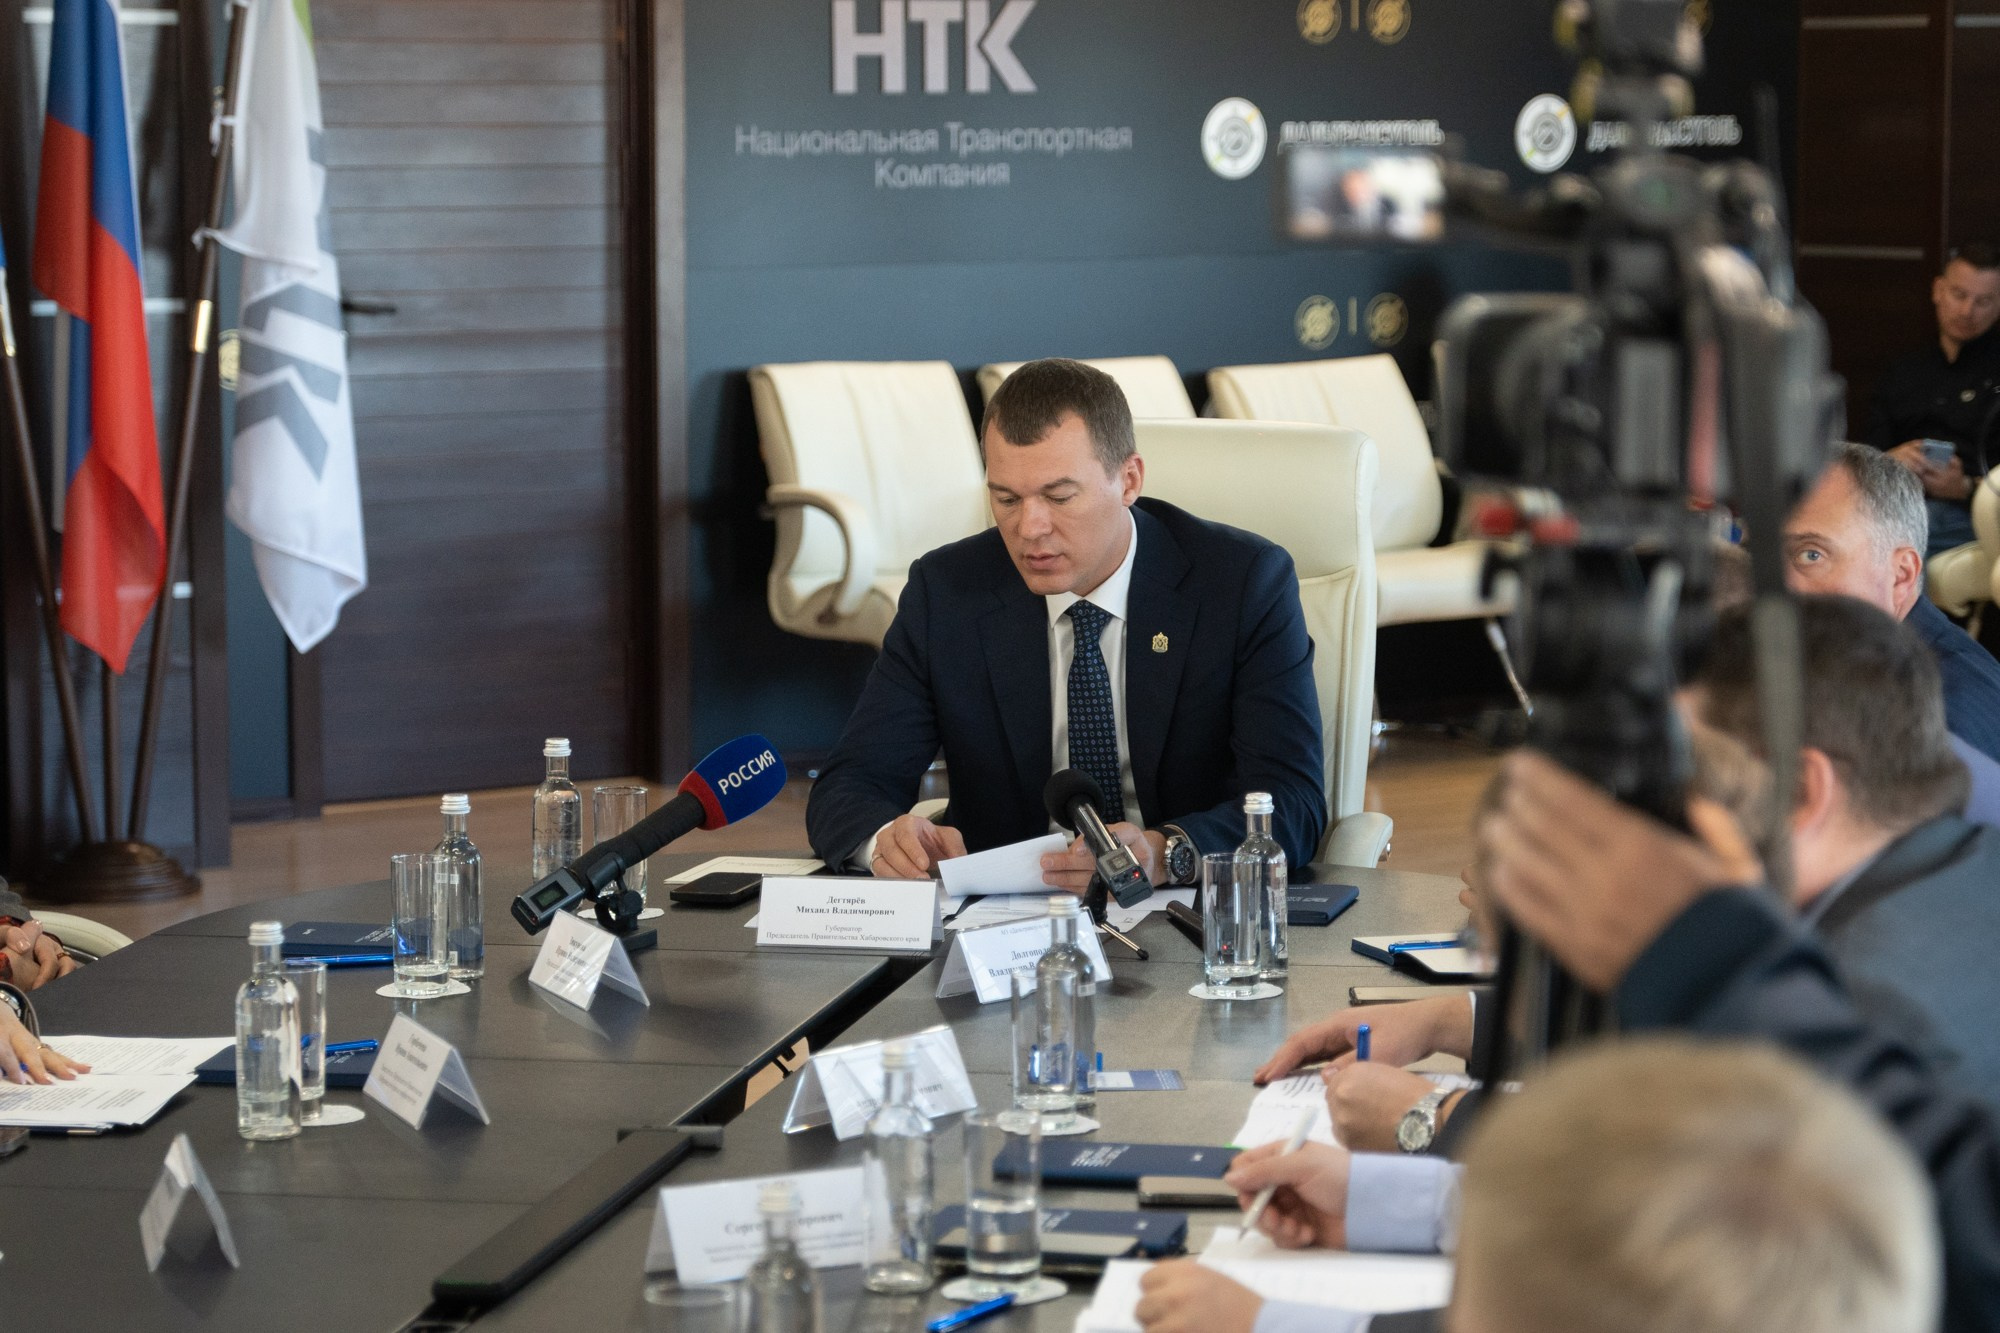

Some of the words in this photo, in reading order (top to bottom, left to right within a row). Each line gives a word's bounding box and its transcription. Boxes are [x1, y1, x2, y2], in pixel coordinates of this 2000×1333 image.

[831, 0, 1038, 94] НТК
[735, 124, 939, 158] Национальная
[944, 121, 1133, 158] Транспортная
[874, 158, 1011, 188] Компания
[718, 749, 777, 796] РОССИЯ
[826, 895, 866, 905] Дегтярёв
[796, 905, 830, 914] Михаил
[832, 906, 895, 916] Владимирович
[825, 924, 863, 932] Губернатор
[766, 931, 810, 940] Председатель
[811, 933, 858, 941] Правительства
[859, 934, 904, 943] Хабаровского
[1011, 946, 1053, 961] Долгополо
